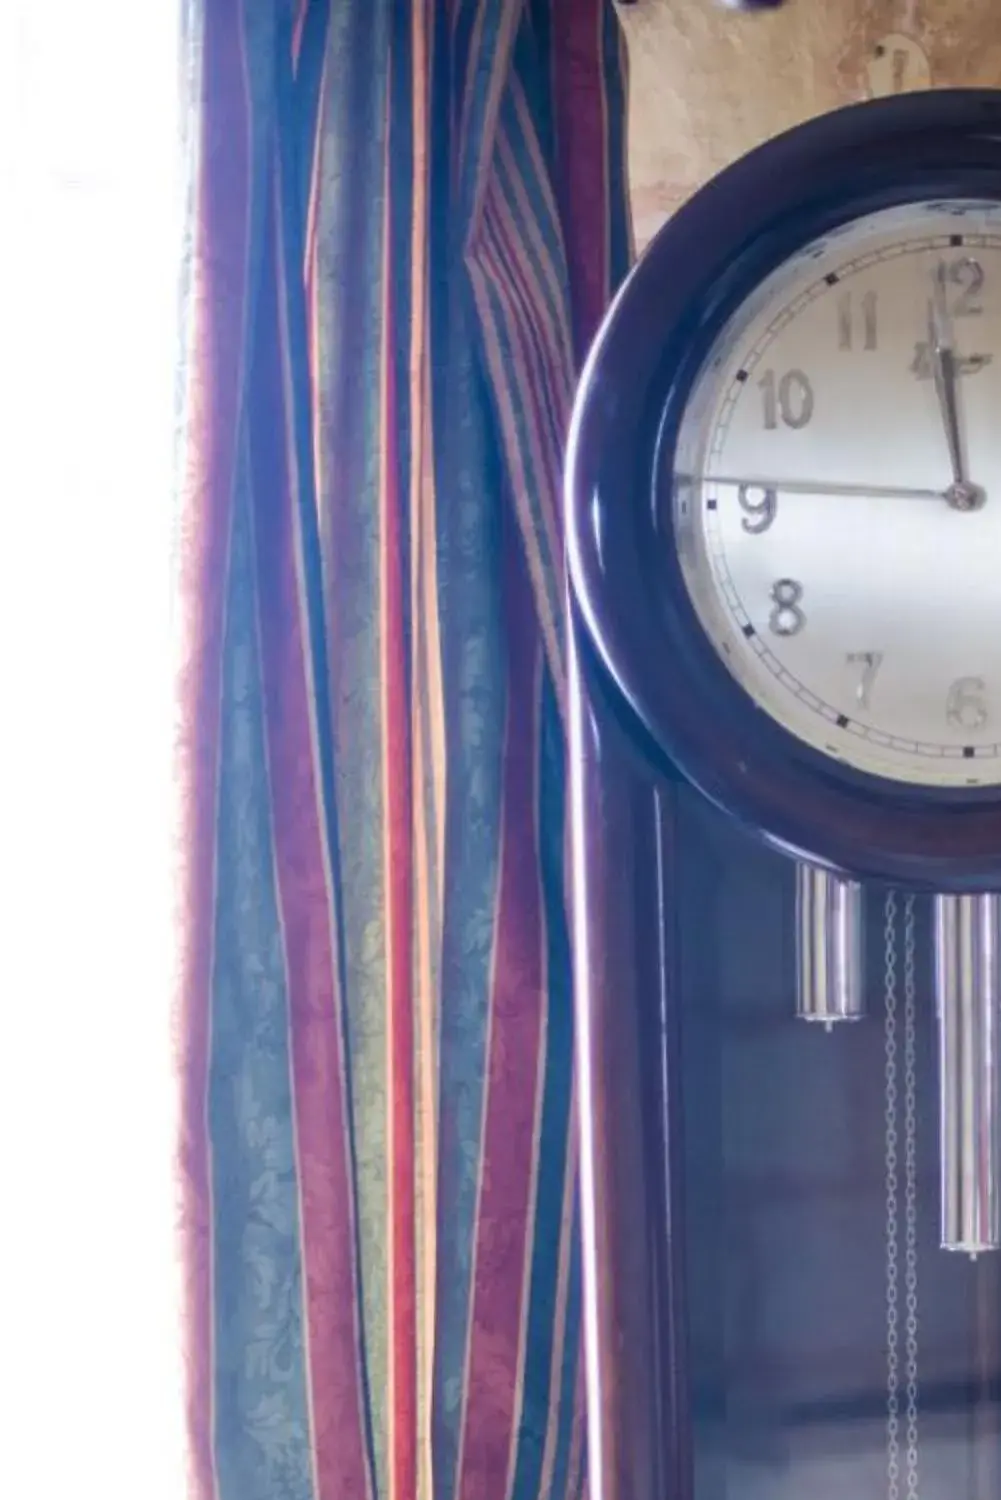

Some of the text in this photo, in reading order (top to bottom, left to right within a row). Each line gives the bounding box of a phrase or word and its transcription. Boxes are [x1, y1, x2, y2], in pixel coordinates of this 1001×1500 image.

[932, 256, 986, 317] 12
[837, 290, 878, 351] 11
[757, 368, 814, 430] 10
[737, 481, 778, 534] 9
[768, 579, 805, 636] 8
[845, 651, 883, 710] 7
[945, 676, 989, 731] 6
